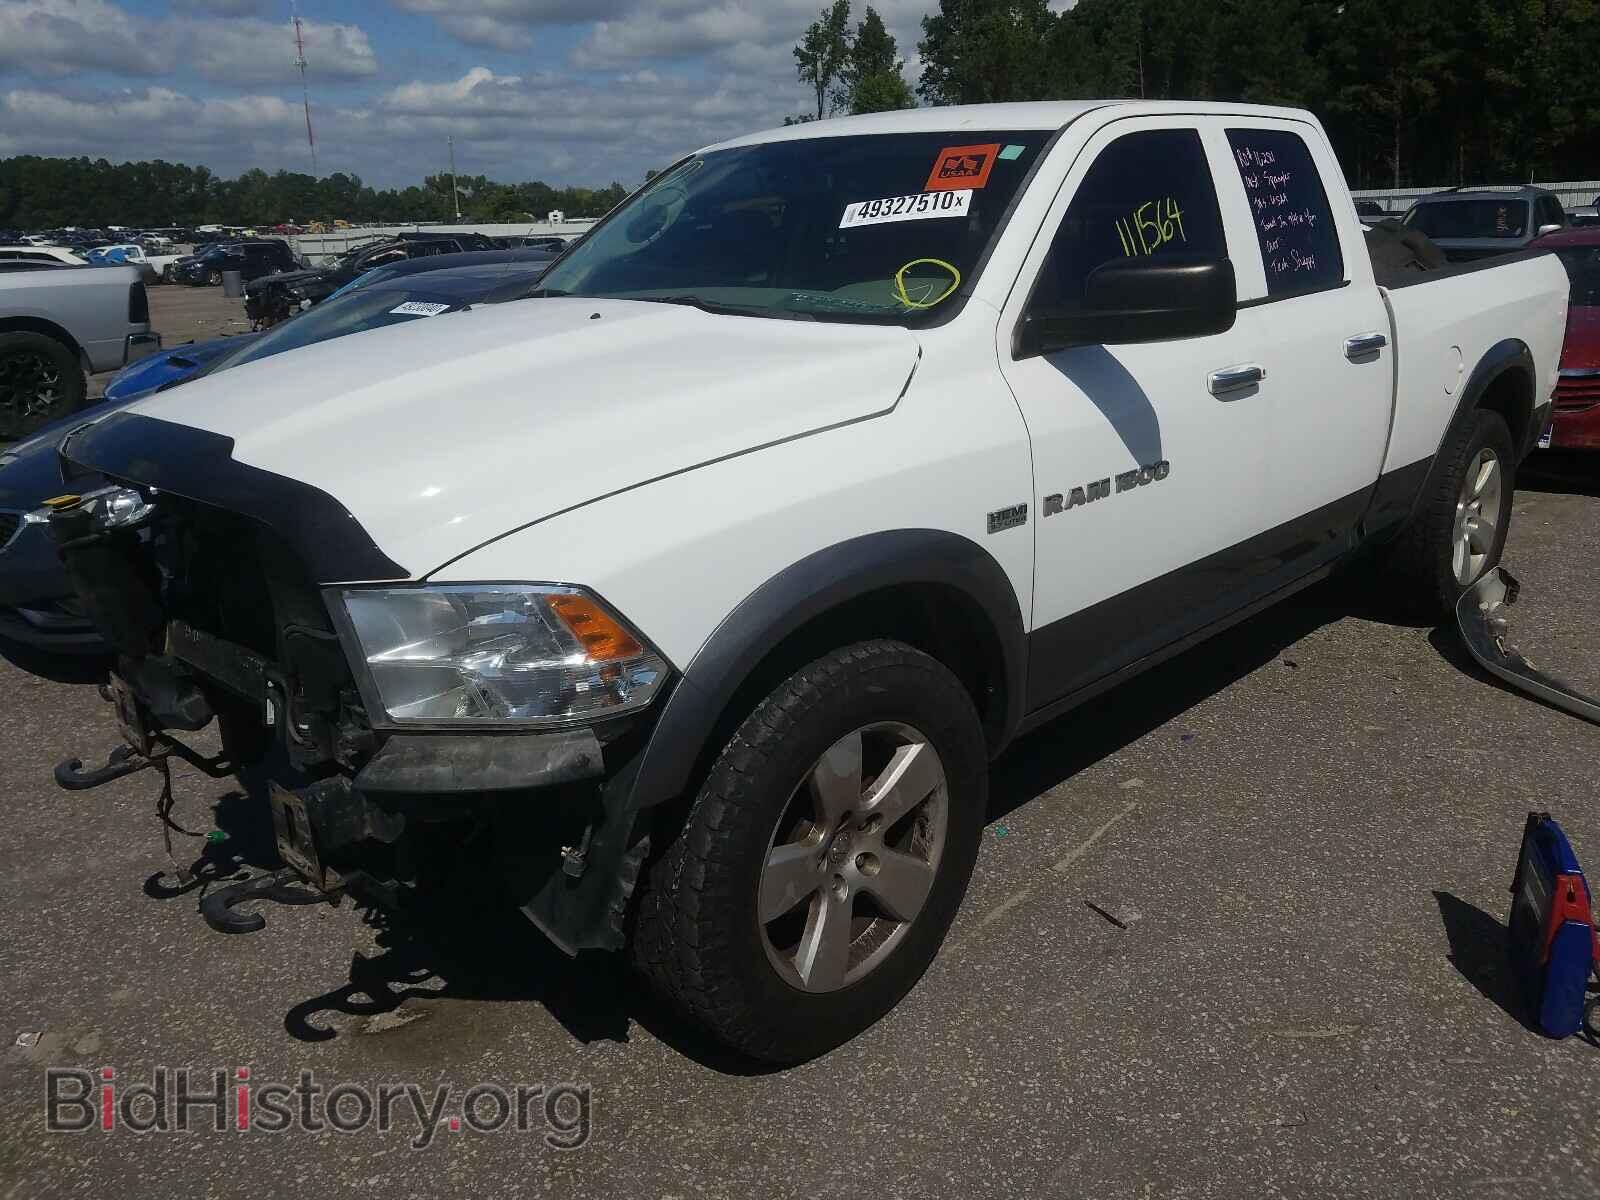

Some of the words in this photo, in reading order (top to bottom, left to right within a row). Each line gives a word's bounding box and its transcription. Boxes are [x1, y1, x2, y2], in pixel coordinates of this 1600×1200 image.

[1115, 197, 1186, 256] 111,564
[989, 503, 1028, 521] HEMI
[1042, 477, 1111, 517] RAM
[1114, 460, 1170, 493] 1500
